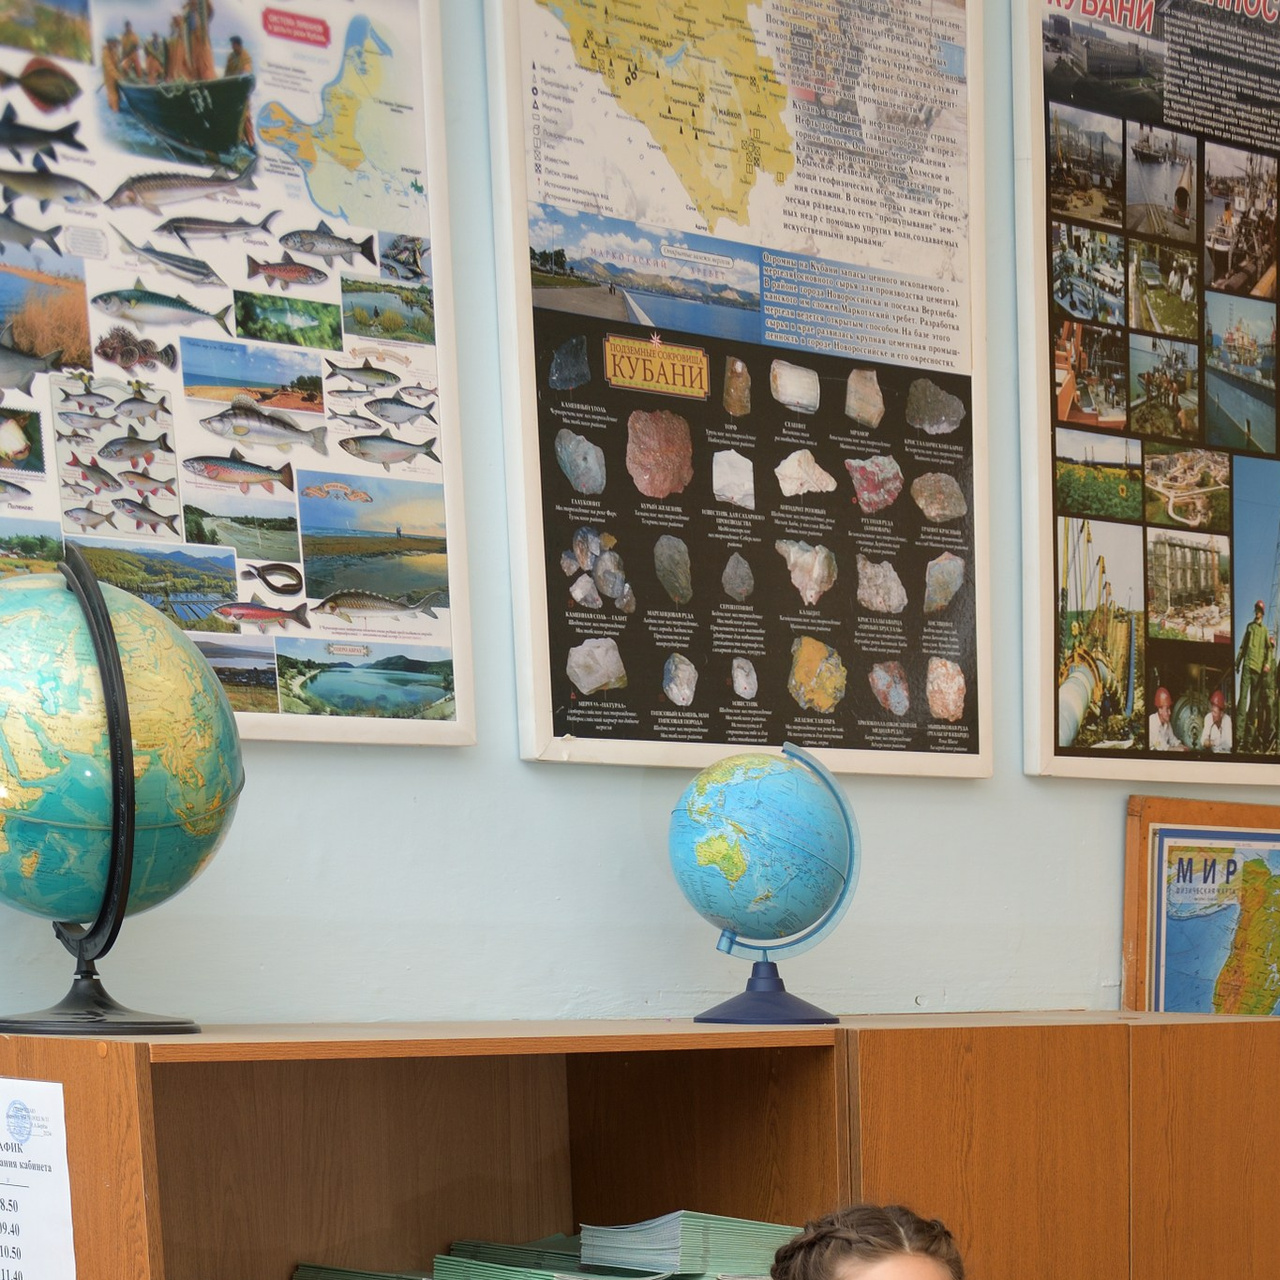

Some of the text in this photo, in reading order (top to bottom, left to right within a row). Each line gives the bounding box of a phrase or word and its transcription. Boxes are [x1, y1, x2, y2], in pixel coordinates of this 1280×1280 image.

[639, 34, 672, 48] КРАСНОДАР
[718, 109, 741, 120] МАЙКОП
[543, 180, 569, 191] Источники
[571, 198, 603, 210] минеральных
[785, 196, 809, 206] ческая
[857, 210, 872, 219] есть
[939, 226, 953, 234] зем-
[794, 185, 960, 223] ния скважин. В основе первых лежит сейсми-
[783, 209, 797, 217] ных
[826, 217, 859, 230] помощью
[862, 224, 891, 237] упругих
[783, 222, 883, 248] искусственными взрывами.
[763, 253, 796, 268] Огромны
[810, 262, 837, 276] Кубани
[840, 269, 866, 279] запасы
[868, 273, 897, 285] ценного
[899, 279, 944, 293] ископаемого
[764, 279, 769, 287] В
[772, 281, 797, 294] районе
[800, 286, 824, 298] города
[826, 289, 881, 307] Новороссийска
[891, 301, 919, 312] поселка
[921, 305, 957, 320] Верхнеба-
[835, 280, 857, 291] сырья
[860, 284, 873, 293] для
[875, 286, 923, 302] производства
[926, 294, 959, 307] цемента).
[764, 292, 959, 333] канского им сложен Маркотхский хребет. Разработка
[764, 305, 794, 320] мергеля
[796, 311, 824, 323] ведется
[826, 315, 863, 329] открытым
[913, 329, 929, 339] базе
[931, 333, 950, 343] этого
[765, 331, 798, 343] ленность
[807, 338, 830, 350] городе
[833, 341, 887, 356] Новороссийске
[897, 352, 908, 360] его
[766, 319, 788, 331] сырья
[798, 324, 814, 335] крае
[816, 327, 853, 342] развилась
[855, 333, 886, 347] крупная
[888, 338, 926, 352] цементная
[928, 344, 960, 357] промыш-
[610, 343, 703, 365] ПОДЗЕМНЫЕ СОКРОВИЩА
[611, 353, 704, 389] КУБАНИ
[1176, 857, 1237, 883] МИР
[19, 1159, 51, 1172] кабинета
[0, 1245, 21, 1259] 10.50
